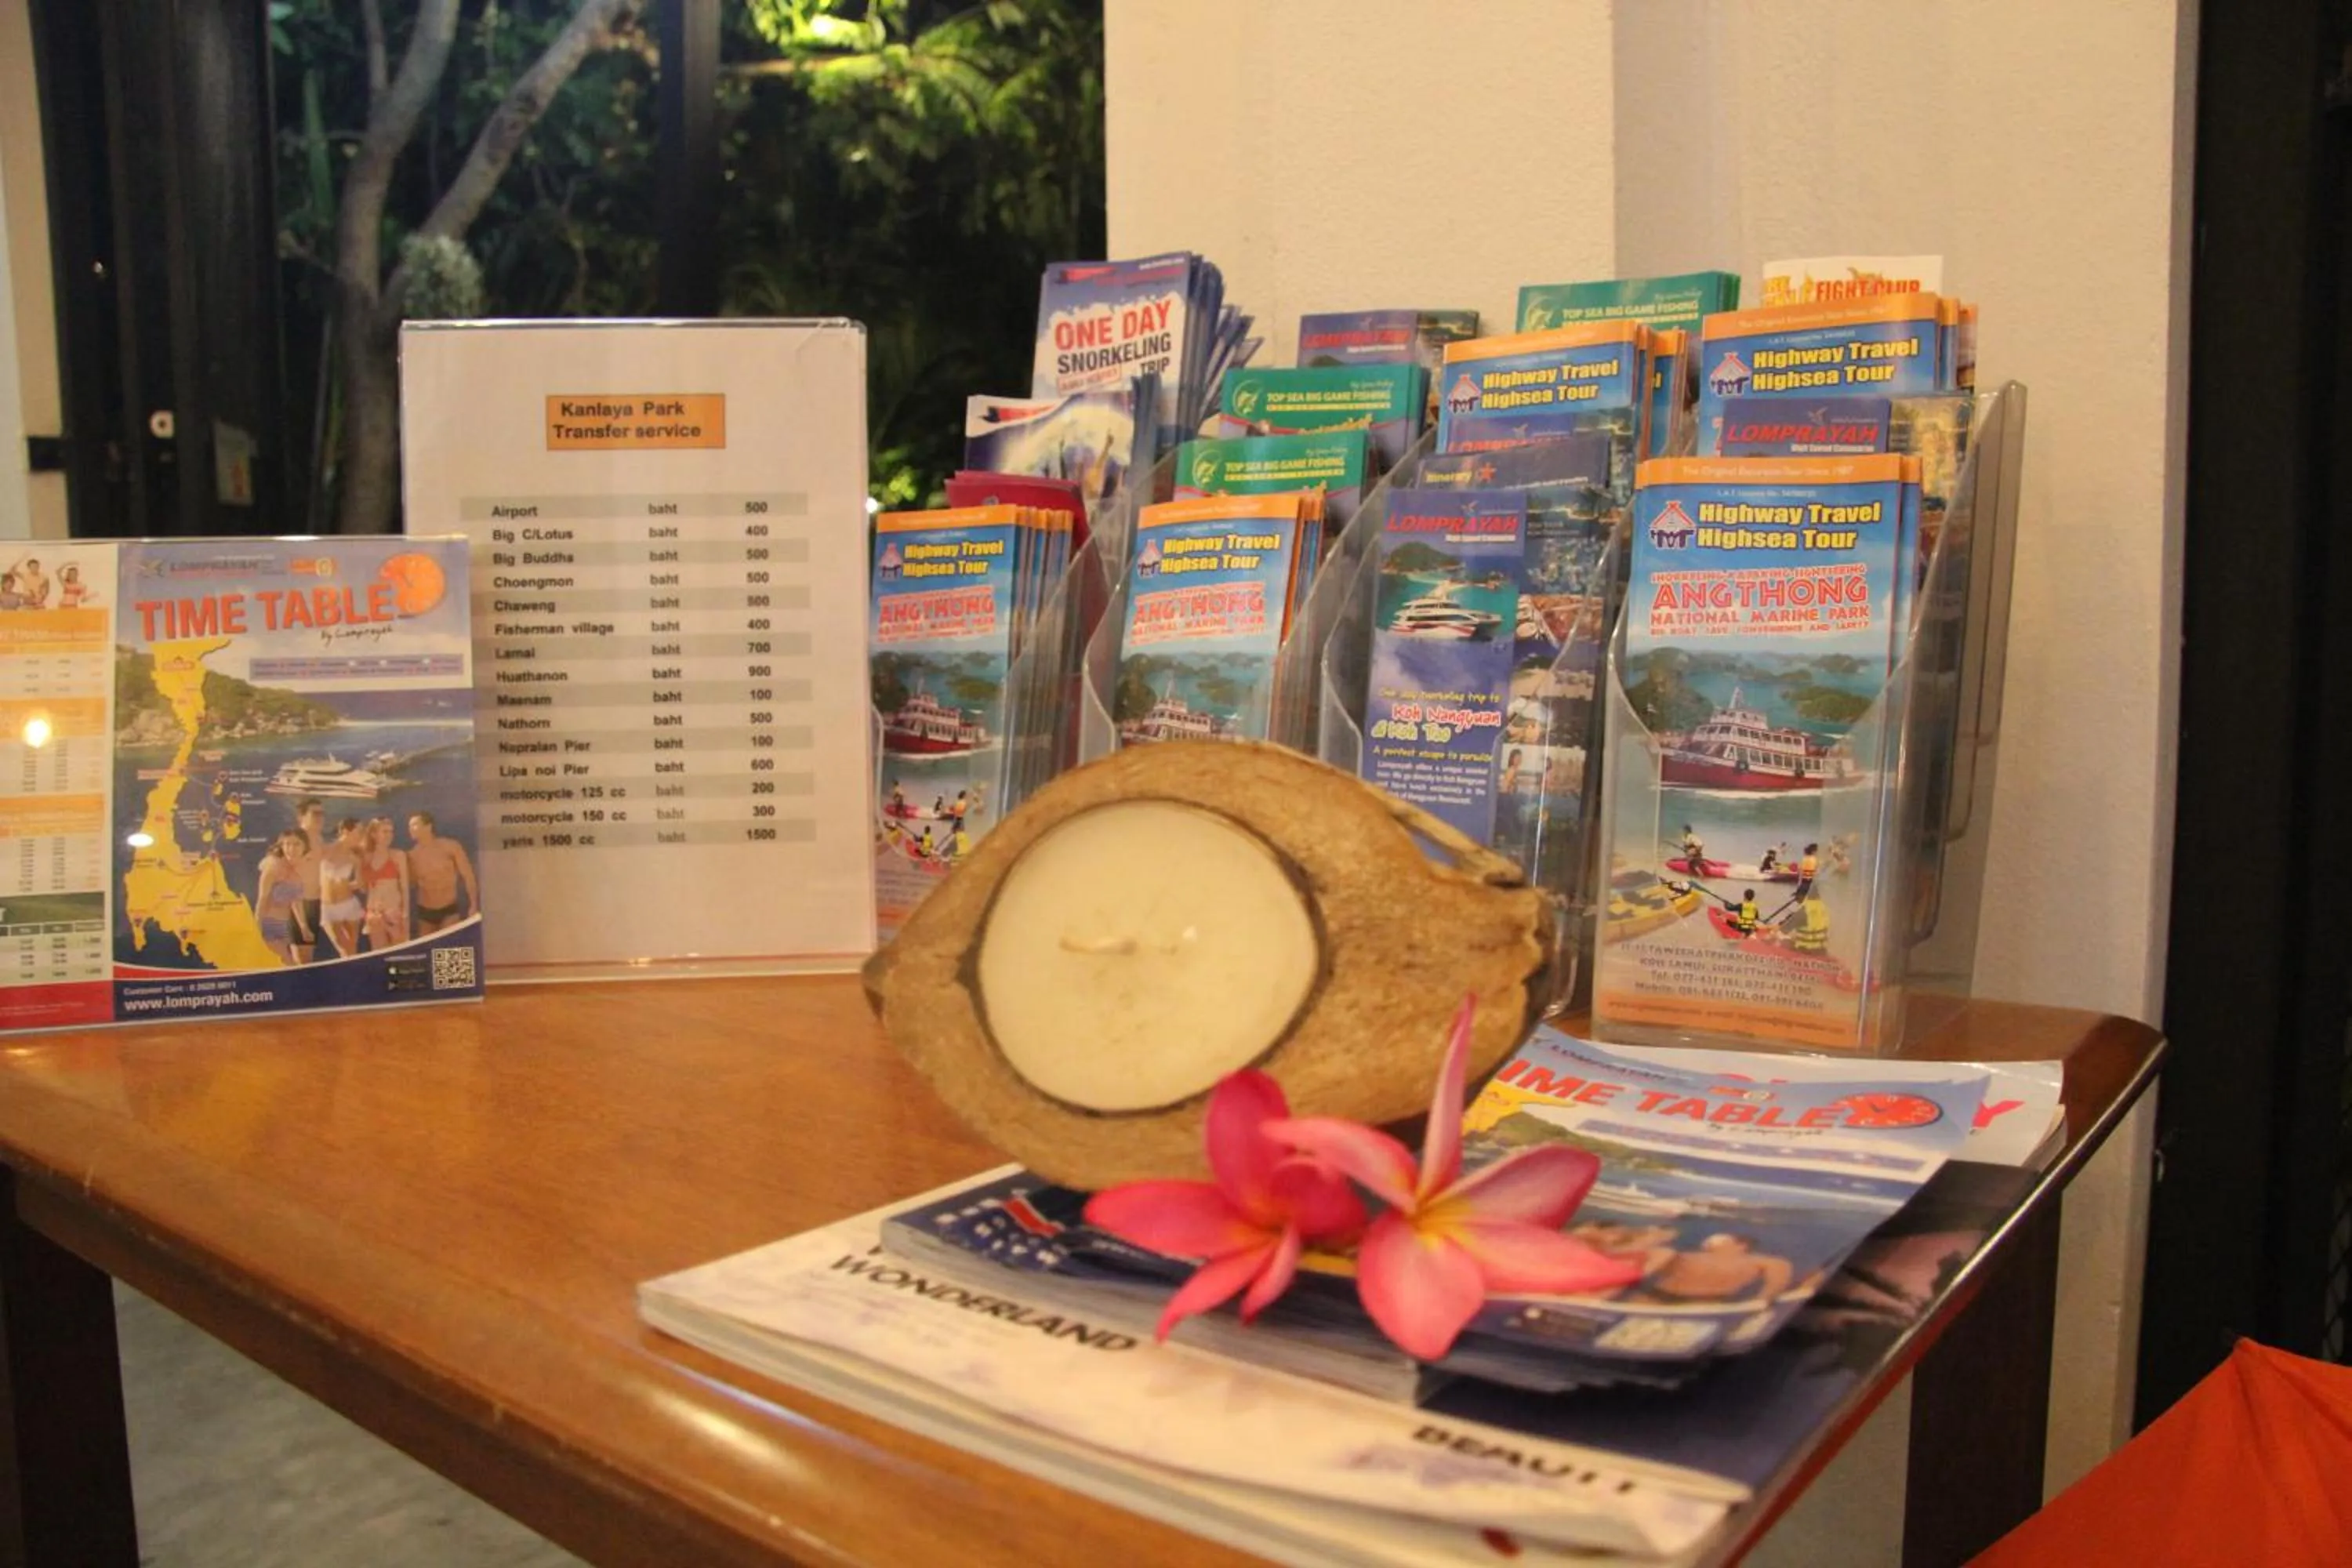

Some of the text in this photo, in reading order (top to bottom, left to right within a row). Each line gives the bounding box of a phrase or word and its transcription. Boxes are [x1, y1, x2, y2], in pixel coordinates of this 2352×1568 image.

[1816, 278, 1868, 301] FIGHT
[1054, 299, 1171, 350] ONE DAY
[1058, 332, 1171, 374] SNORKELING
[1752, 338, 1919, 369] Highway Travel
[1140, 357, 1170, 374] TRIP
[1483, 360, 1620, 390] Highway Travel
[1751, 364, 1895, 392] Highsea Tour
[1267, 393, 1284, 401] TOP
[1323, 391, 1351, 401] GAME
[1480, 384, 1599, 409] Highsea Tour
[561, 401, 684, 419] Kanlaya Park
[552, 423, 701, 440] Transfer service
[1726, 423, 1880, 444] LOMPRAYAH
[492, 502, 768, 520] Airport baht 500
[1698, 502, 1881, 526] Highway Travel
[1386, 515, 1519, 532] LOMPRAYAH
[492, 525, 768, 543] Big C/Lotus baht 400
[1697, 528, 1857, 550] Highsea Tour
[904, 539, 1004, 560] Highway Travel
[1163, 534, 1281, 555] Highway Travel
[492, 549, 768, 567] Big Buddha baht 500
[1160, 554, 1261, 574] Highsea Tour
[902, 560, 989, 578] Highsea Tour
[493, 572, 769, 590] Choengmon baht 500
[135, 584, 394, 641] TIME TABLE
[494, 599, 556, 613] Chaweng
[650, 597, 680, 609] baht
[1650, 605, 1869, 626] NATIONAL MARINE PARK
[495, 619, 770, 635] Fisherman village baht 400
[652, 644, 681, 655] baht
[747, 642, 771, 654] 700
[496, 666, 771, 683] Huathanon baht 900
[497, 689, 771, 706] Maenam baht 100
[498, 712, 772, 729] Nathorn baht 500
[1392, 702, 1501, 733] Koh Nangyuan
[1388, 721, 1417, 740] Koh
[1422, 723, 1451, 742] Tao
[565, 740, 590, 752] Pier
[655, 738, 683, 750] baht
[751, 735, 773, 747] 100
[1373, 746, 1381, 754] A
[499, 759, 774, 778] Lipa noi Pier baht 600
[500, 782, 774, 801] motorcycle 125 cc baht 200
[501, 805, 775, 825] motorcycle 150 cc baht 300
[502, 829, 775, 849] yaris 1500 cc baht 1500
[124, 990, 274, 1011] www.lomprayah.com
[1497, 1059, 1840, 1128] IME TABLE
[829, 1253, 1139, 1352] WONDERLAND
